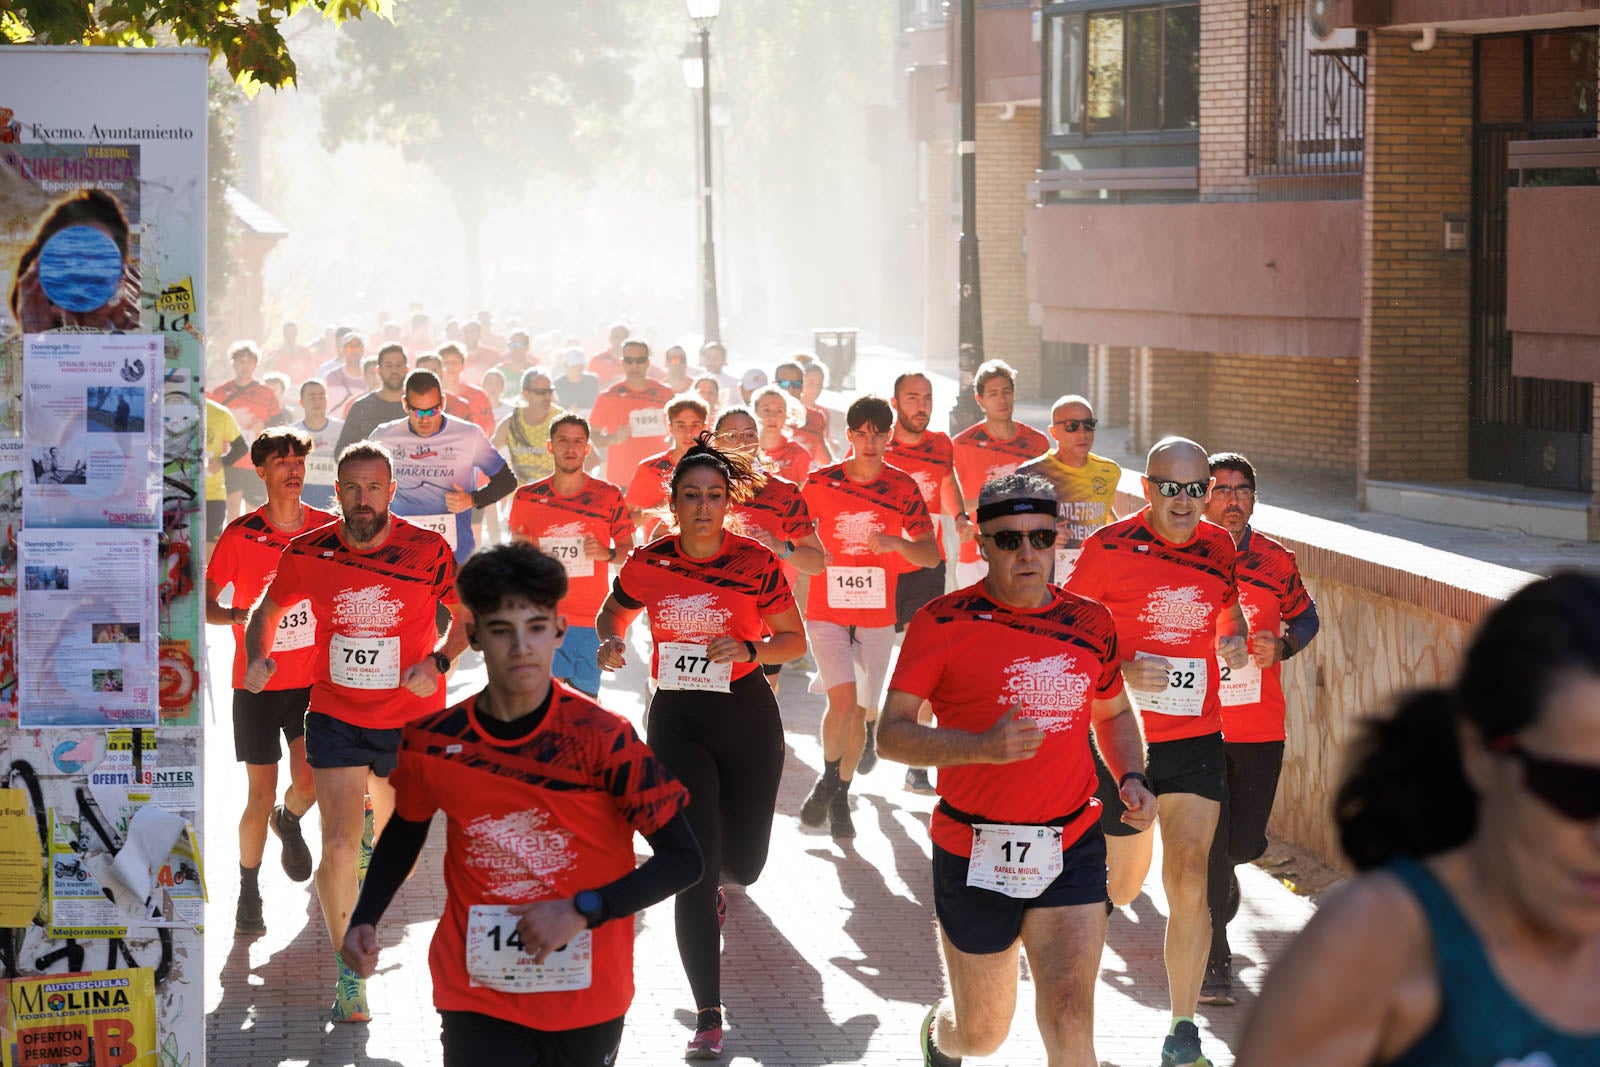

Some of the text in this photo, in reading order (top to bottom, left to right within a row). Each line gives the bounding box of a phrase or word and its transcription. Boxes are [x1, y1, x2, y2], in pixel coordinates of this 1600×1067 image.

[32, 123, 194, 144] Excmo. Ayuntamiento
[42, 180, 124, 191] Espejos de Amor
[176, 292, 190, 302] NO
[396, 468, 455, 478] MARACENA
[1060, 501, 1106, 521] ATLETISMO
[551, 546, 578, 558] 579
[836, 575, 873, 588] 1461
[336, 602, 397, 615] carrera
[659, 608, 725, 624] carrera
[1148, 600, 1208, 617] carrera
[343, 647, 380, 665] 767
[674, 655, 711, 674] 477
[1009, 676, 1085, 693] carrera
[1009, 692, 1083, 707] cruzroja.es
[93, 773, 129, 785] OFERTA
[471, 833, 565, 851] carrera
[1001, 840, 1031, 863] 17
[994, 865, 1041, 875] RAFAEL MIGUEL
[53, 928, 114, 938] Mejoramos
[44, 979, 129, 993] AUTOESCUELAS
[19, 1006, 131, 1021] TODOS LOS PERMISOS
[24, 1046, 83, 1061] PERMISO
